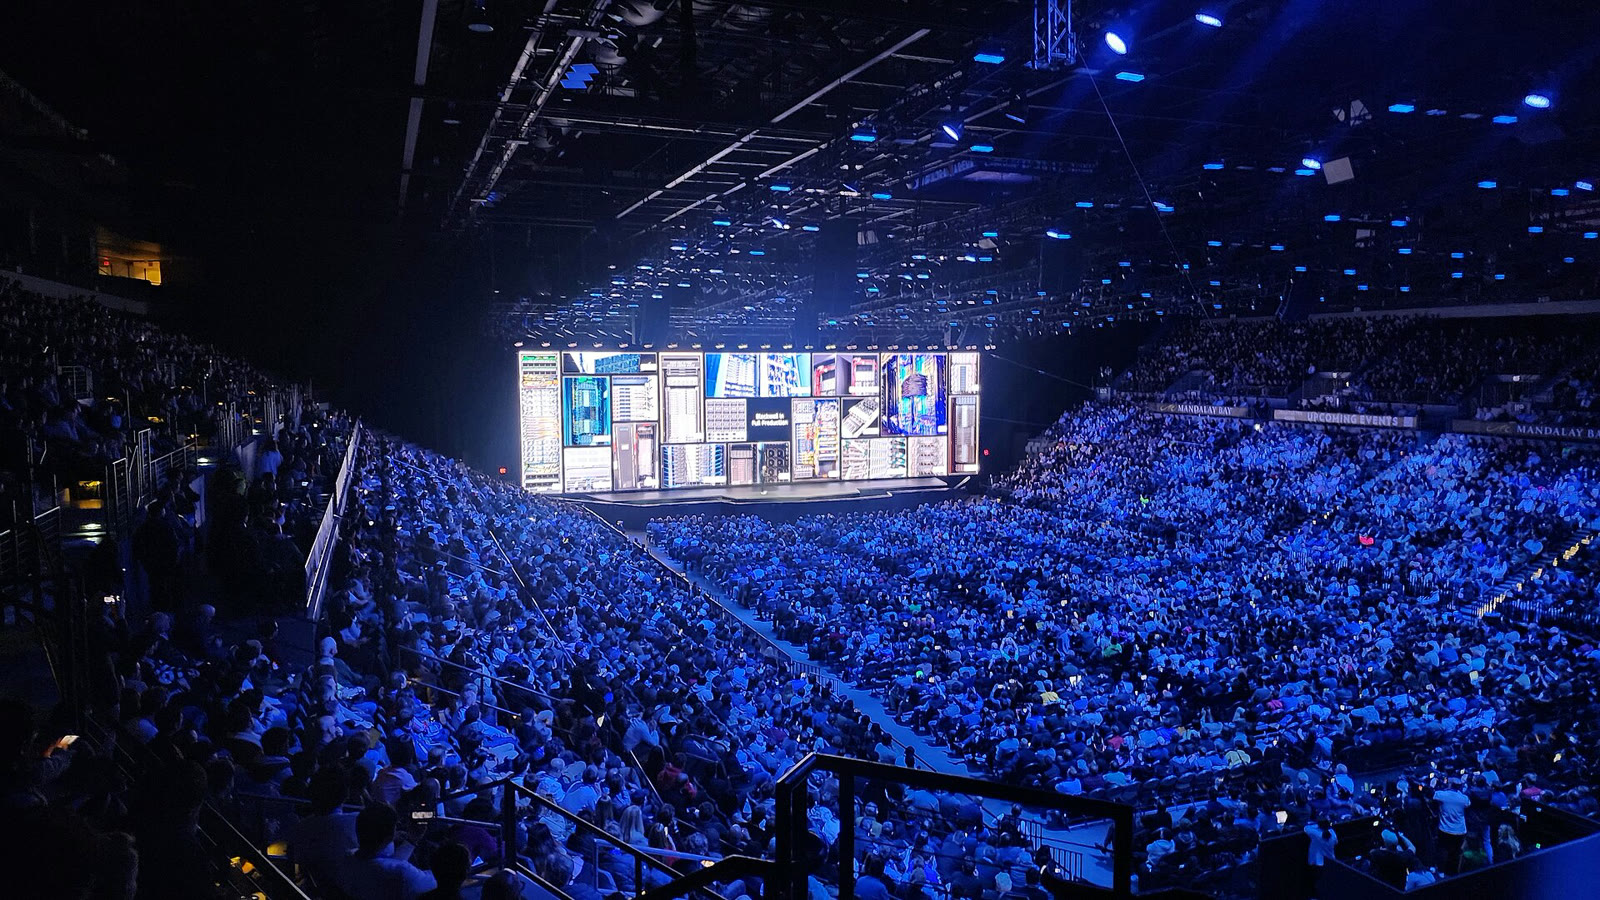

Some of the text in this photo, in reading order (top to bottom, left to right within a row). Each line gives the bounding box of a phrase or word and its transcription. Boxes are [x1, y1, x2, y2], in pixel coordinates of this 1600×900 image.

[1177, 404, 1232, 415] MANDALAY BAY
[1307, 412, 1357, 425] UPCOMING
[1359, 414, 1398, 427] EVENTS
[1516, 424, 1583, 437] MANDALAY
